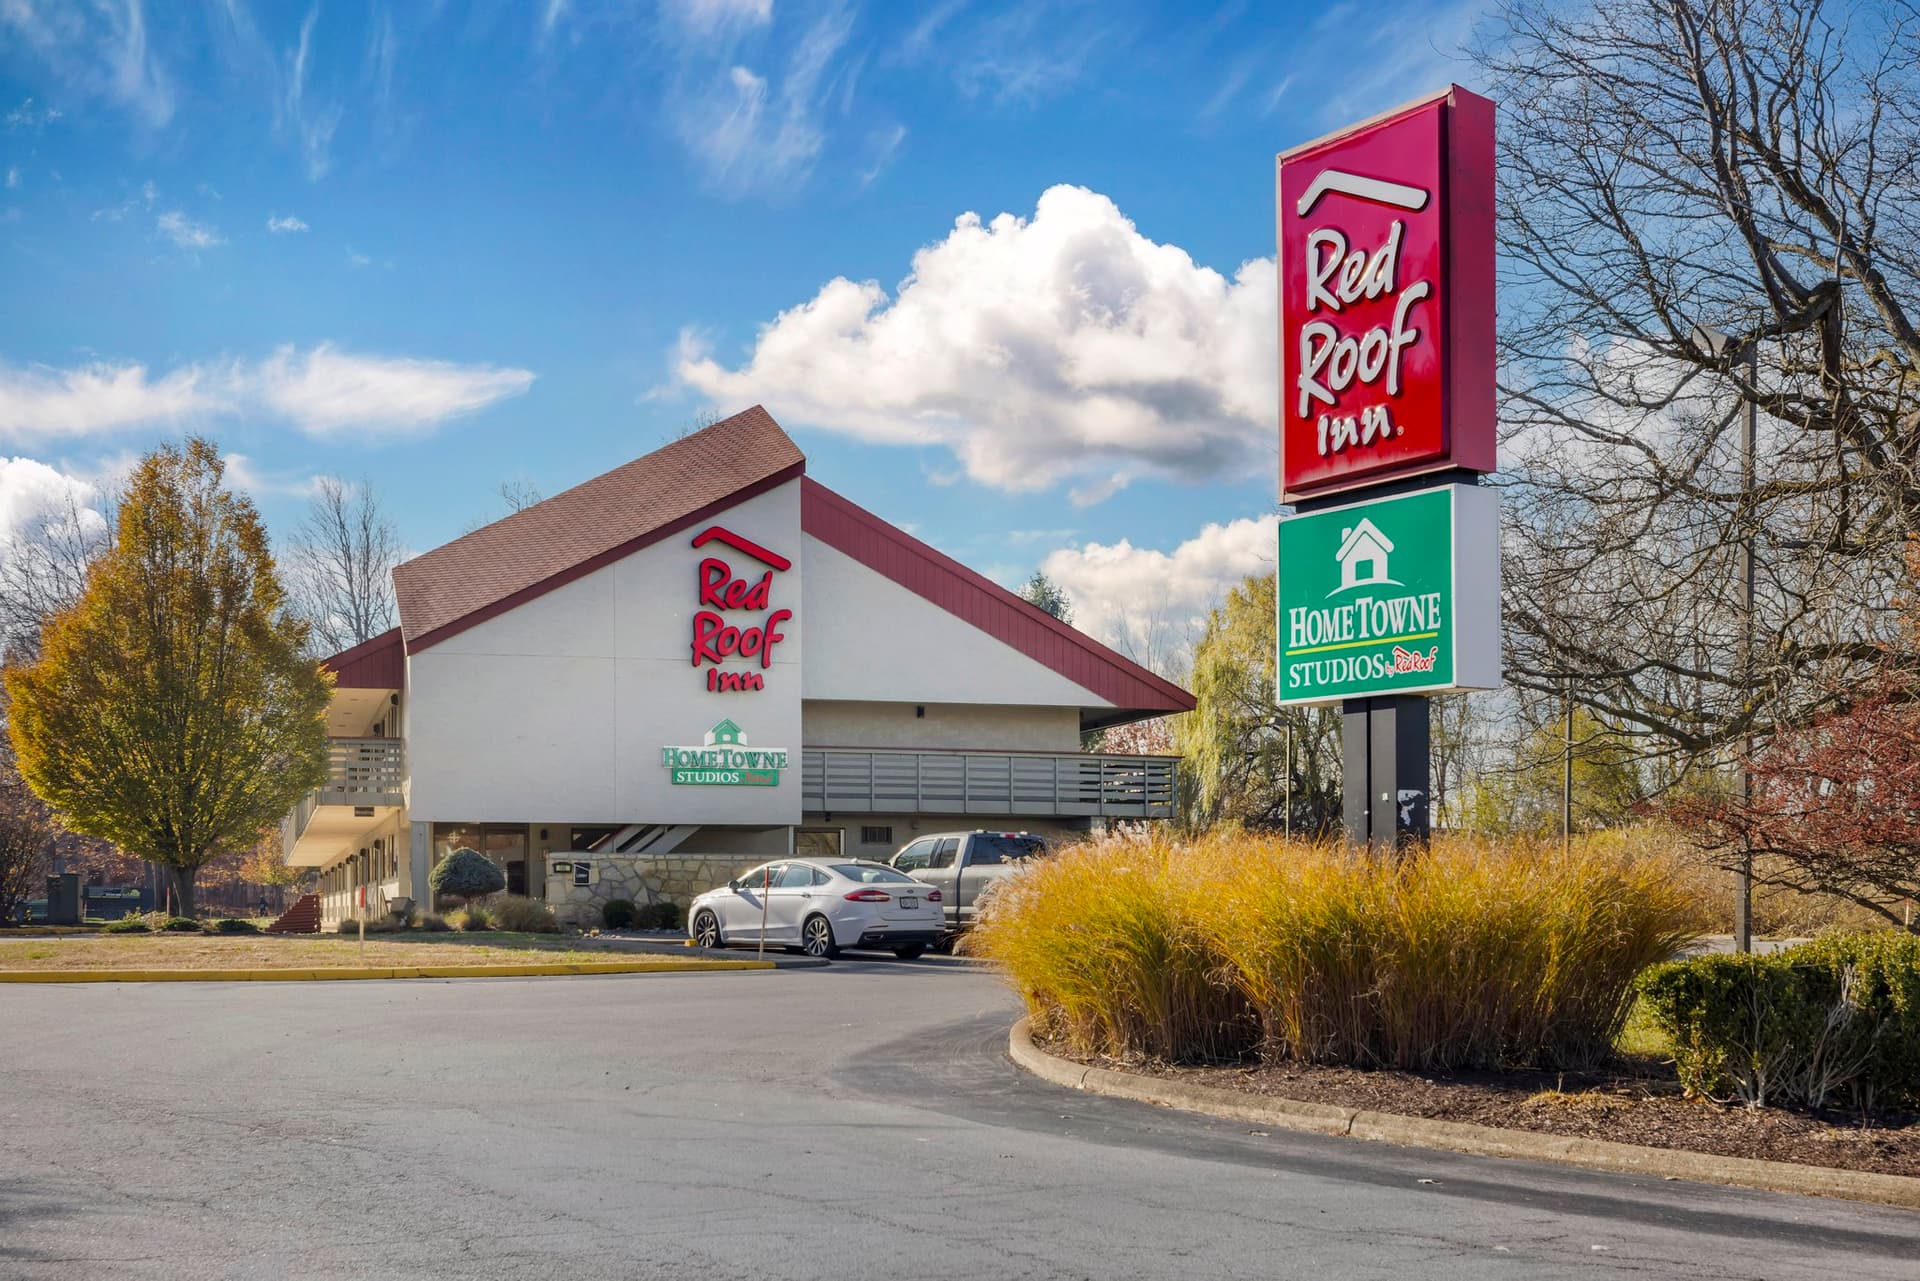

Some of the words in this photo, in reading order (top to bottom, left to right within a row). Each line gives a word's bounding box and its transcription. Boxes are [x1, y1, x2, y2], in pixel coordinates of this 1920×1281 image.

[1306, 220, 1401, 311] Red
[1298, 280, 1431, 418] Roof
[699, 557, 773, 611] Red
[691, 608, 793, 669] Roof
[1289, 653, 1384, 688] STUDIOS
[677, 771, 740, 783] STUDIOS
